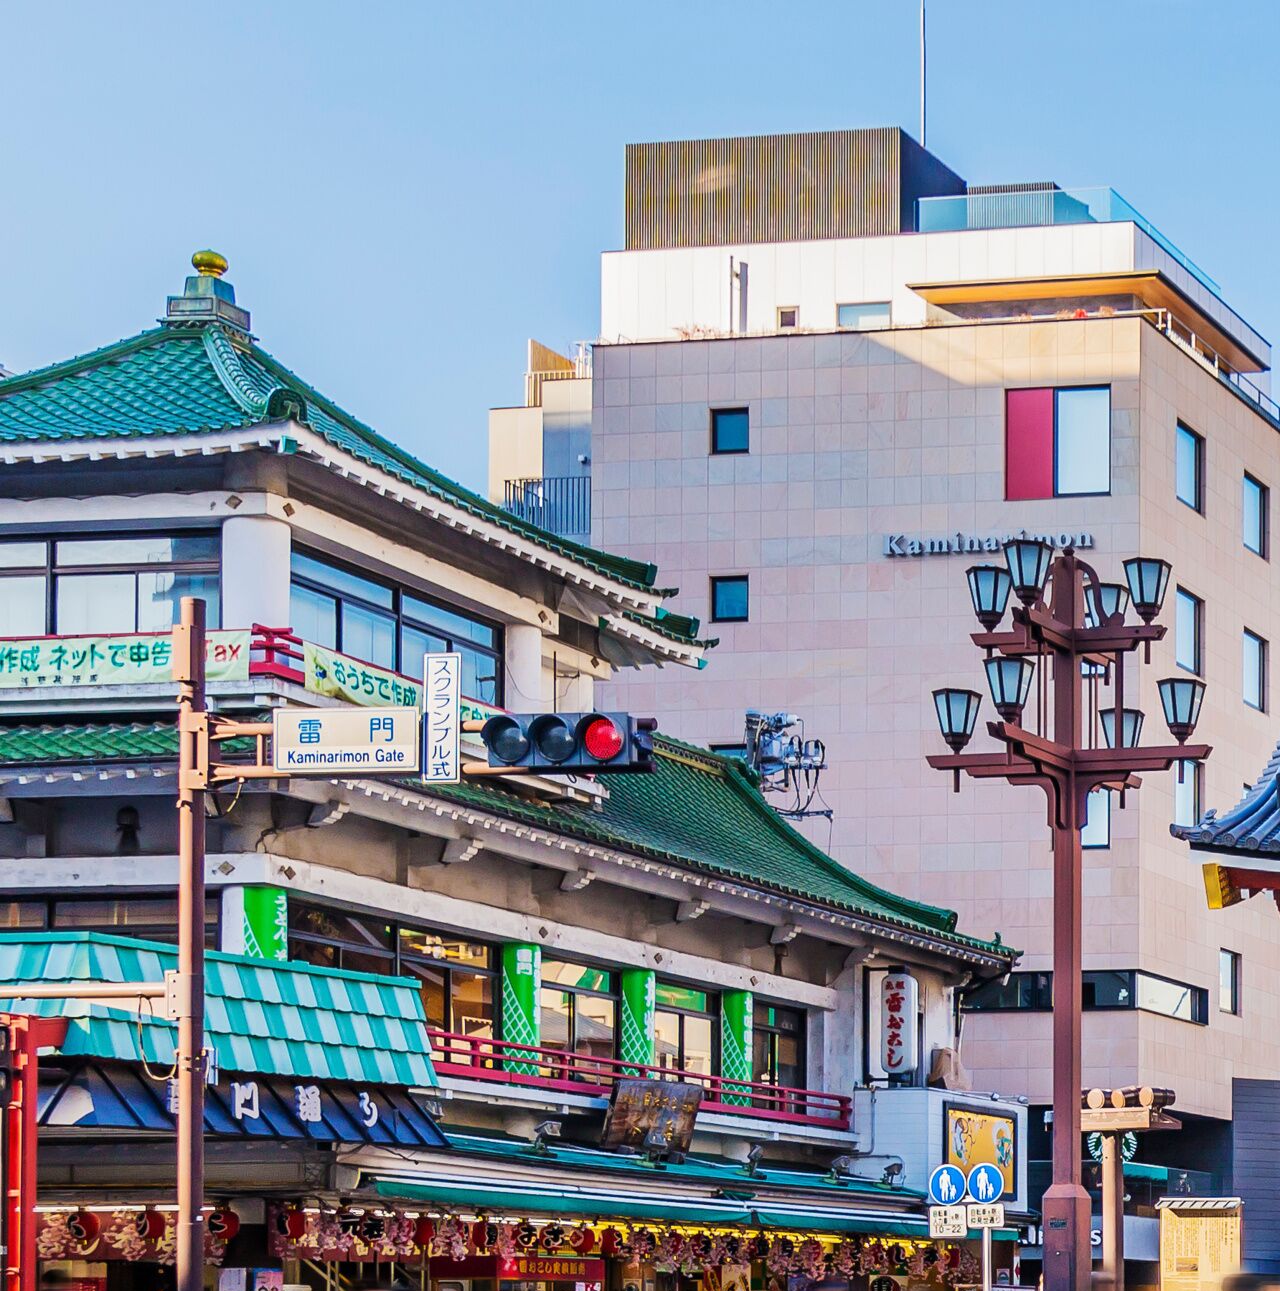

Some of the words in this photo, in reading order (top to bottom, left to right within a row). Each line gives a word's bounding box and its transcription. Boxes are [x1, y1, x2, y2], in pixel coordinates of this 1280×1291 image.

[51, 641, 172, 672] ネットで申告
[333, 660, 417, 707] おうちで作成
[298, 717, 394, 744] 雷門
[432, 660, 451, 777] スクランブル式
[287, 750, 370, 764] Kaminarimon
[375, 749, 404, 763] Gate
[934, 1225, 962, 1234] 10-22
